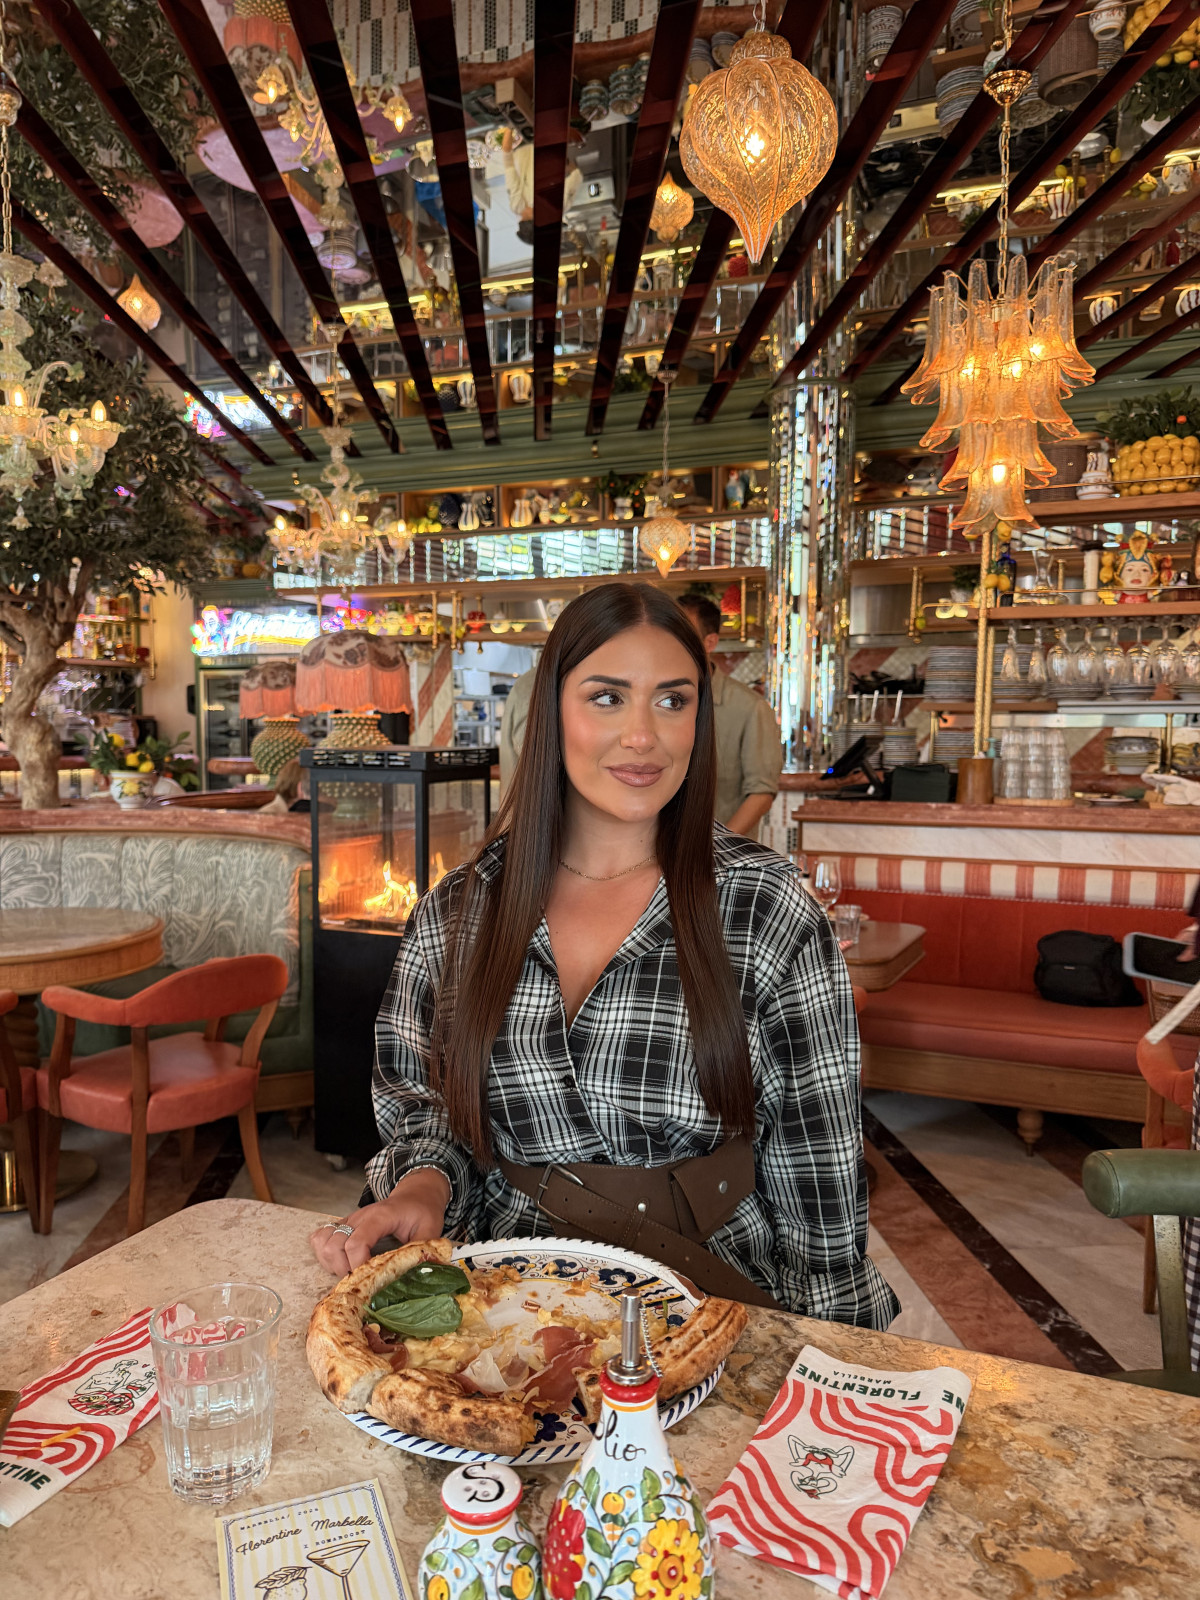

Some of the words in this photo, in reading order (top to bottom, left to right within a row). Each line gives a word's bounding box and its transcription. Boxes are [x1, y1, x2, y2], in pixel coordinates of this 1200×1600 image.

[795, 1363, 921, 1401] FLORENTINE
[833, 1371, 892, 1385] MARBELLA
[462, 1461, 504, 1503] S
[235, 1528, 303, 1556] Florentine
[311, 1515, 375, 1532] Marbella
